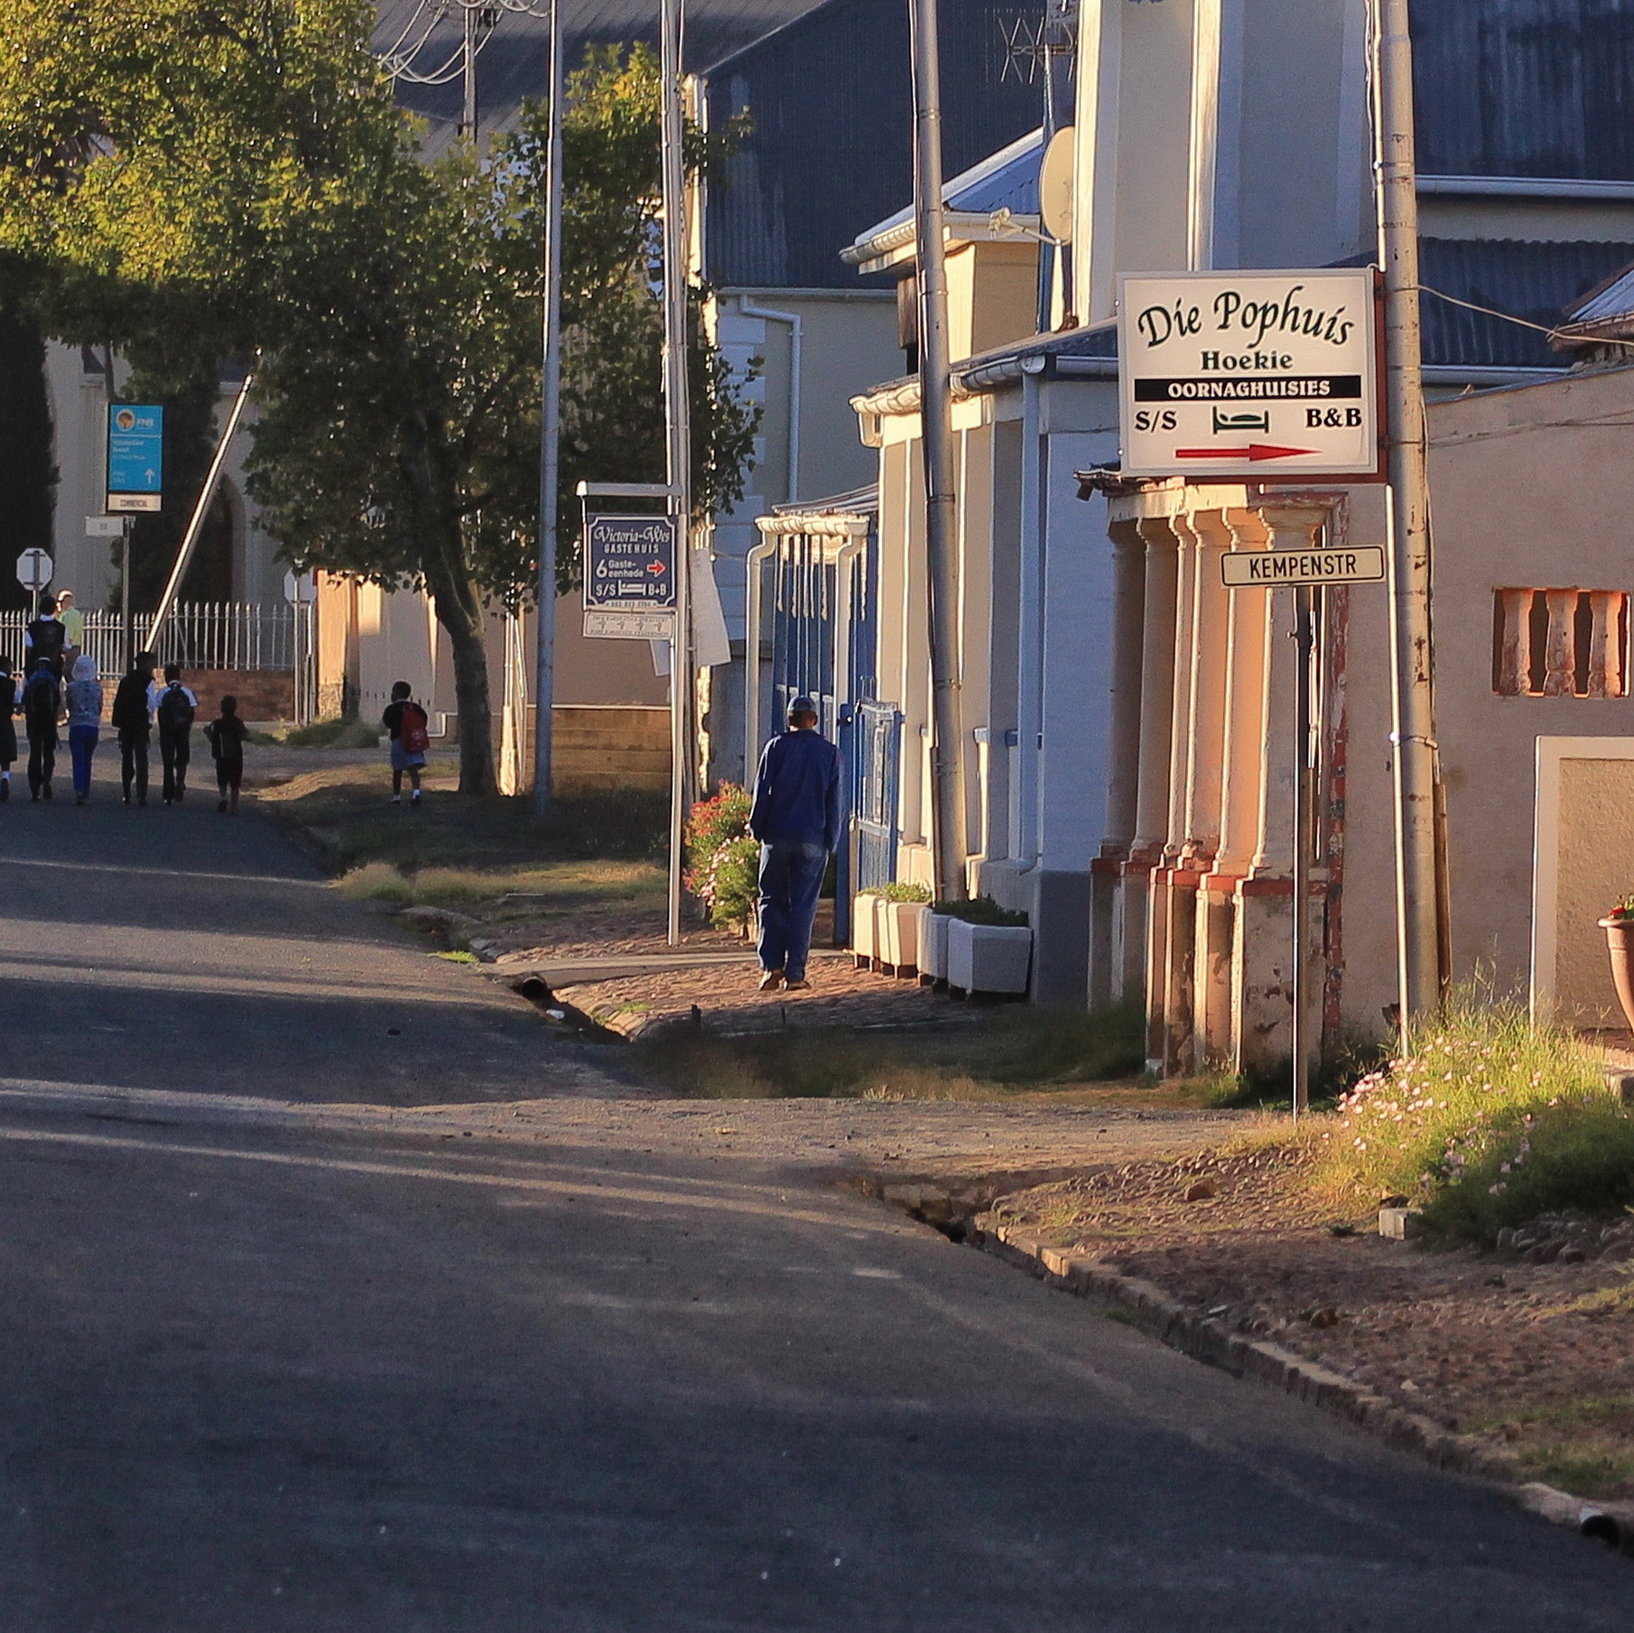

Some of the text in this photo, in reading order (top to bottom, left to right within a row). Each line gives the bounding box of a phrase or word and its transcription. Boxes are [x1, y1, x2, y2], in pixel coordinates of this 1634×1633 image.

[1138, 285, 1355, 349] Die Pophuis
[1200, 350, 1294, 371] Hoekie
[1167, 379, 1332, 399] OORNAGHUISIES
[1134, 407, 1363, 433] S/S B&B
[594, 525, 670, 543] Victoria-Wes
[604, 543, 660, 554] GASTEHUIS
[596, 559, 608, 579] 6
[608, 568, 644, 578] eenhede
[1248, 553, 1358, 579] KEMPENSTR
[596, 583, 617, 597] S/S
